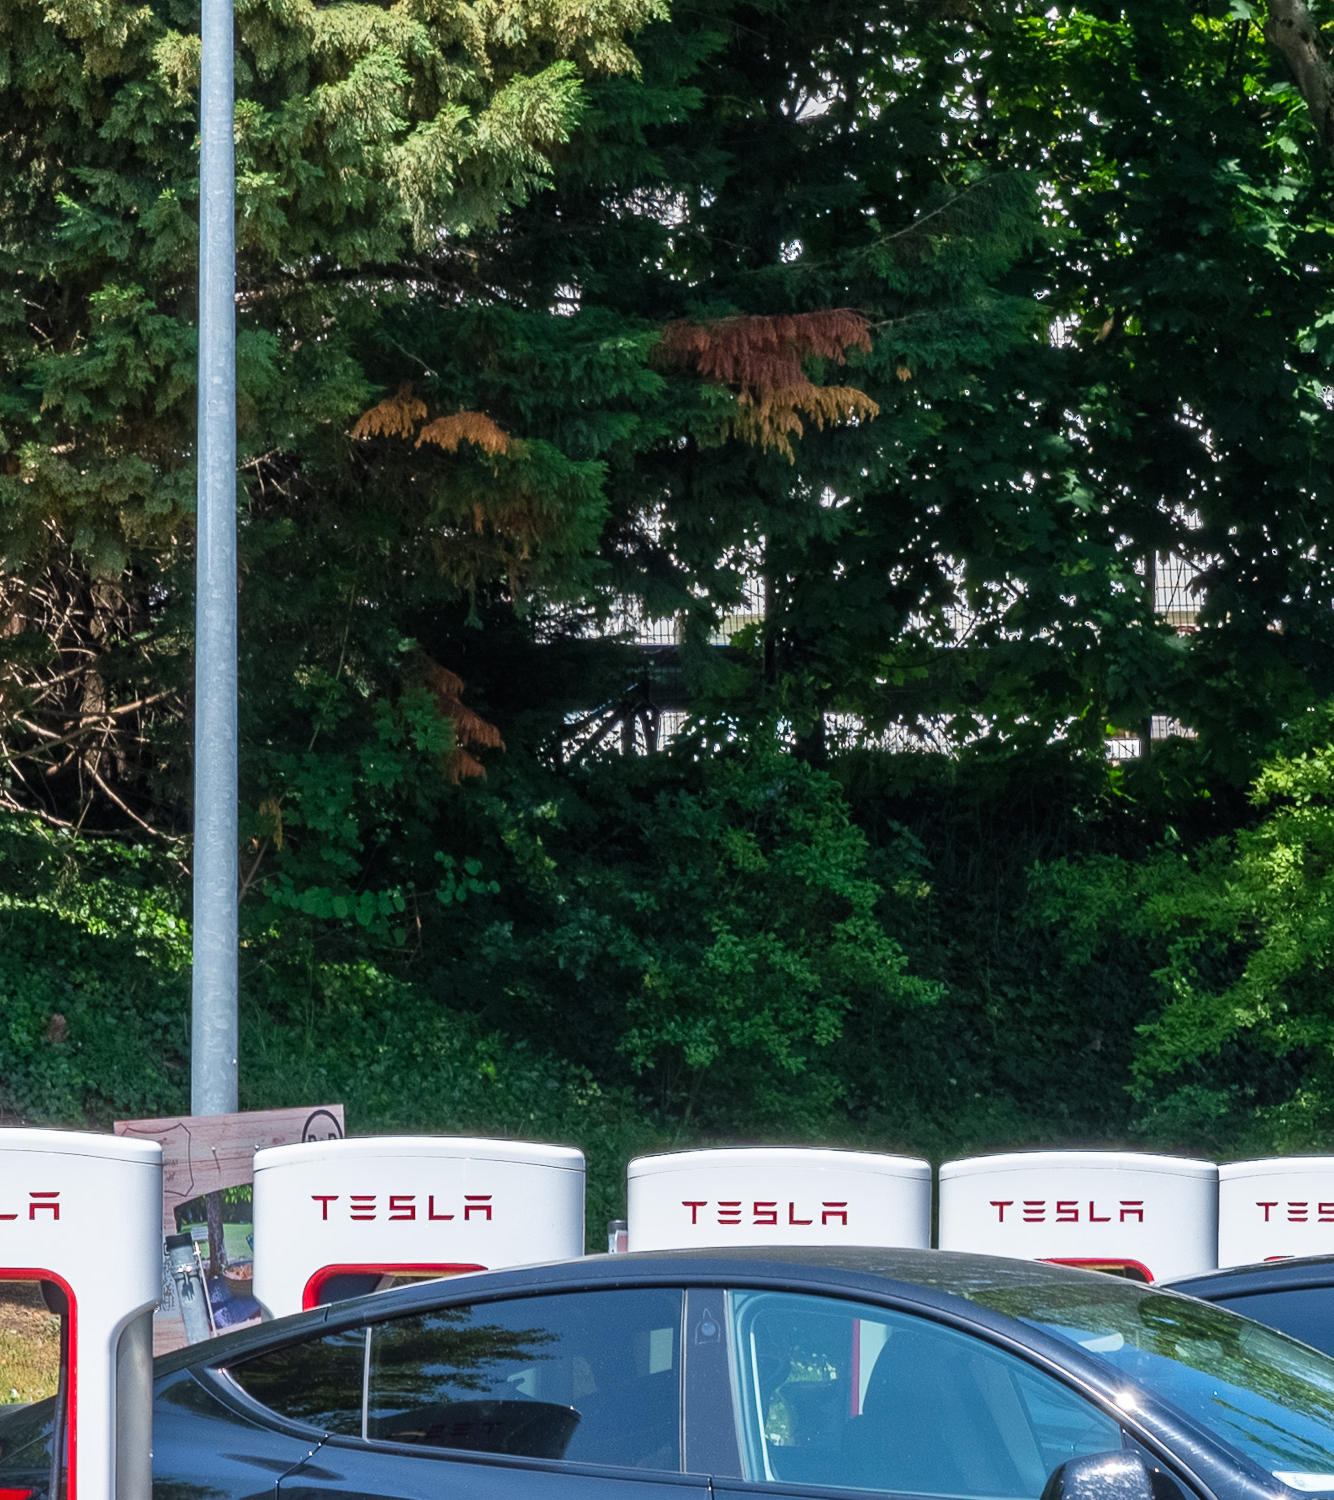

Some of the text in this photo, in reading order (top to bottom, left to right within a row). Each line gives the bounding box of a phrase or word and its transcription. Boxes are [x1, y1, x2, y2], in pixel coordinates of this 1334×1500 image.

[312, 1195, 493, 1221] TESLA
[681, 1201, 848, 1226] TESLA
[989, 1200, 1145, 1223] TESLA
